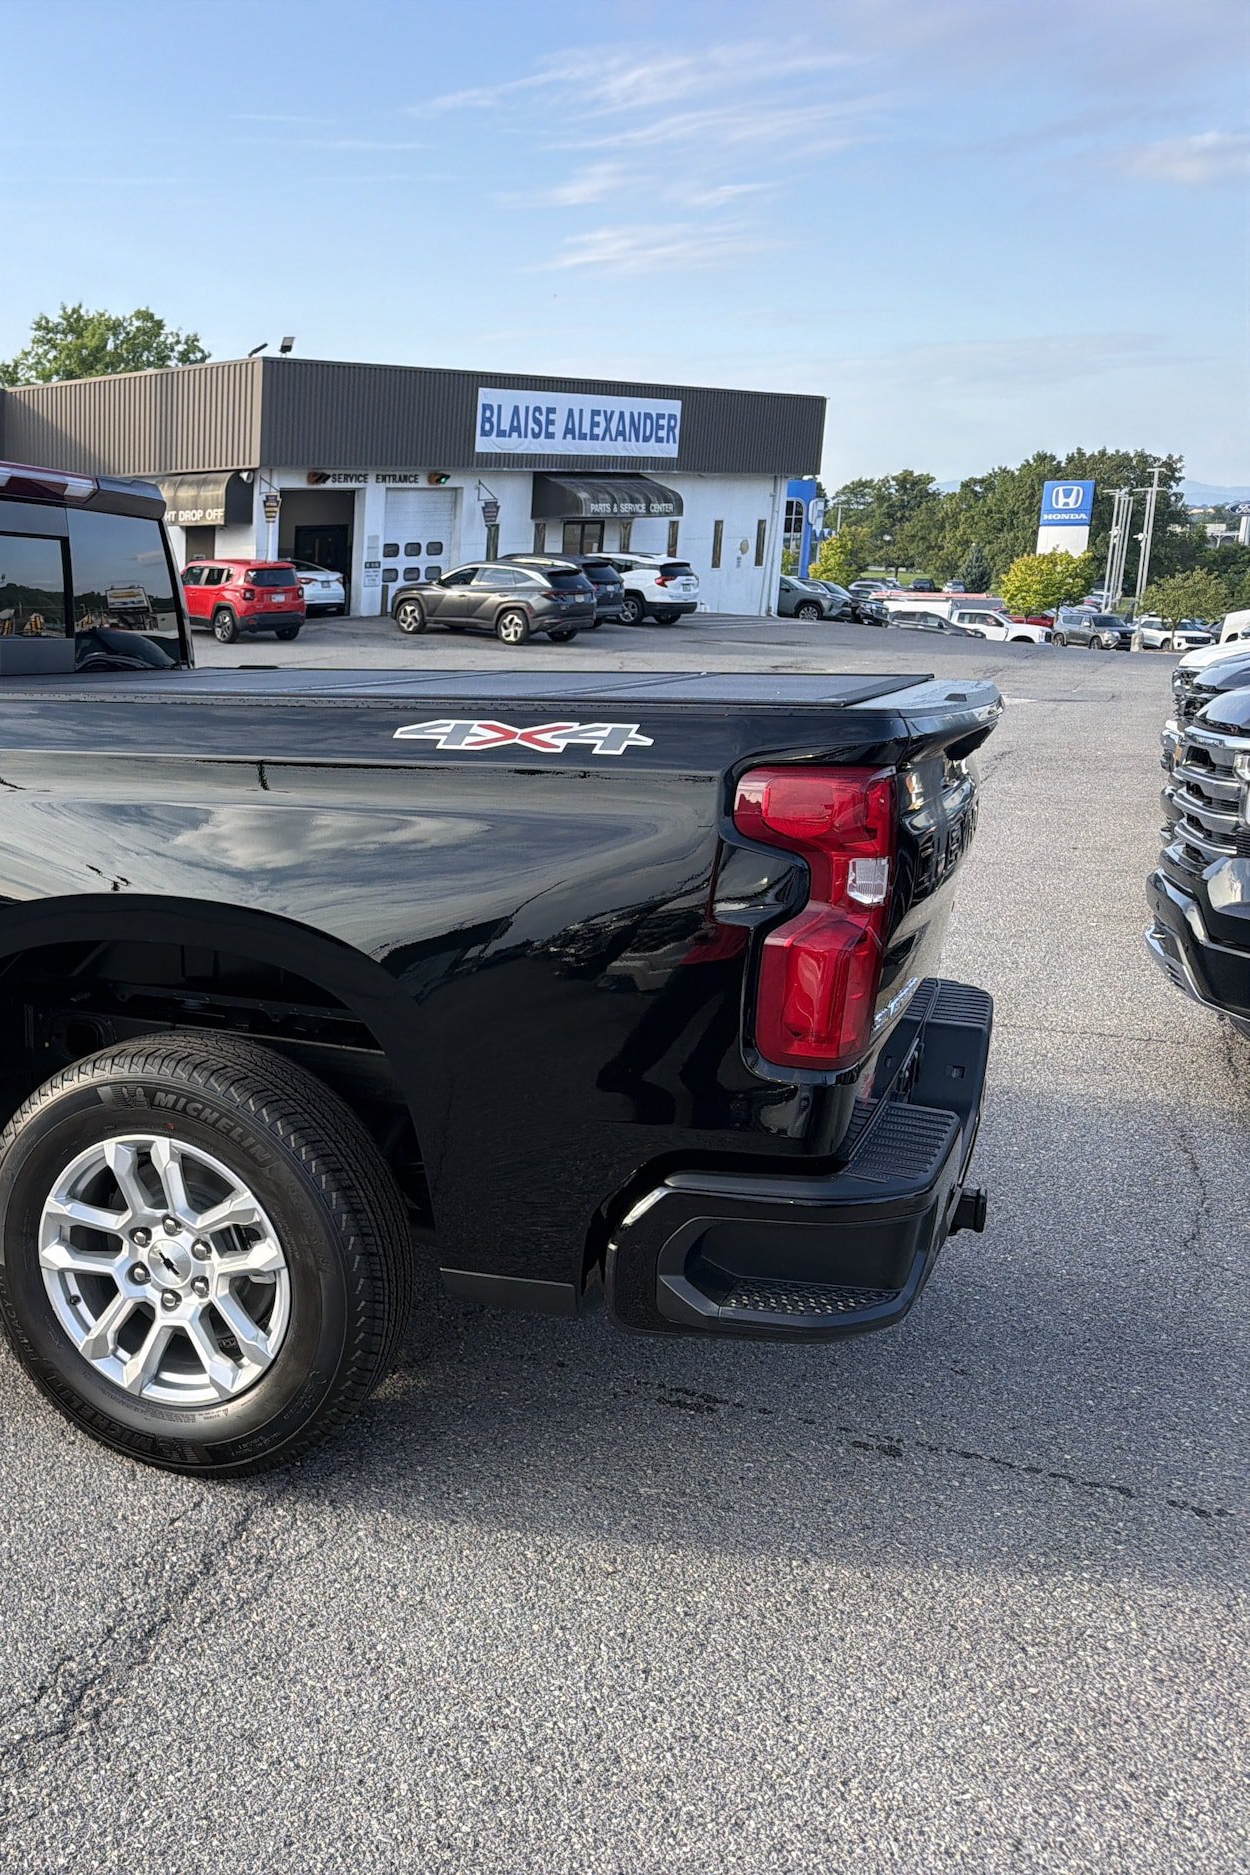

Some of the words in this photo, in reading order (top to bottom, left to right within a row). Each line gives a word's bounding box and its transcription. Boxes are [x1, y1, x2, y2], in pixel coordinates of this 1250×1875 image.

[480, 403, 557, 440] BLAISE
[563, 407, 678, 444] ALEXANDER
[331, 473, 369, 483] SERVICE
[375, 473, 419, 484] ENTRANCE
[178, 509, 204, 522] DROP
[205, 508, 225, 520] OFF
[590, 503, 611, 513] PARTS
[613, 503, 618, 512] &
[619, 503, 646, 513] SERVICE
[649, 503, 674, 513] CENTER
[152, 1091, 272, 1167] MICHELIN
